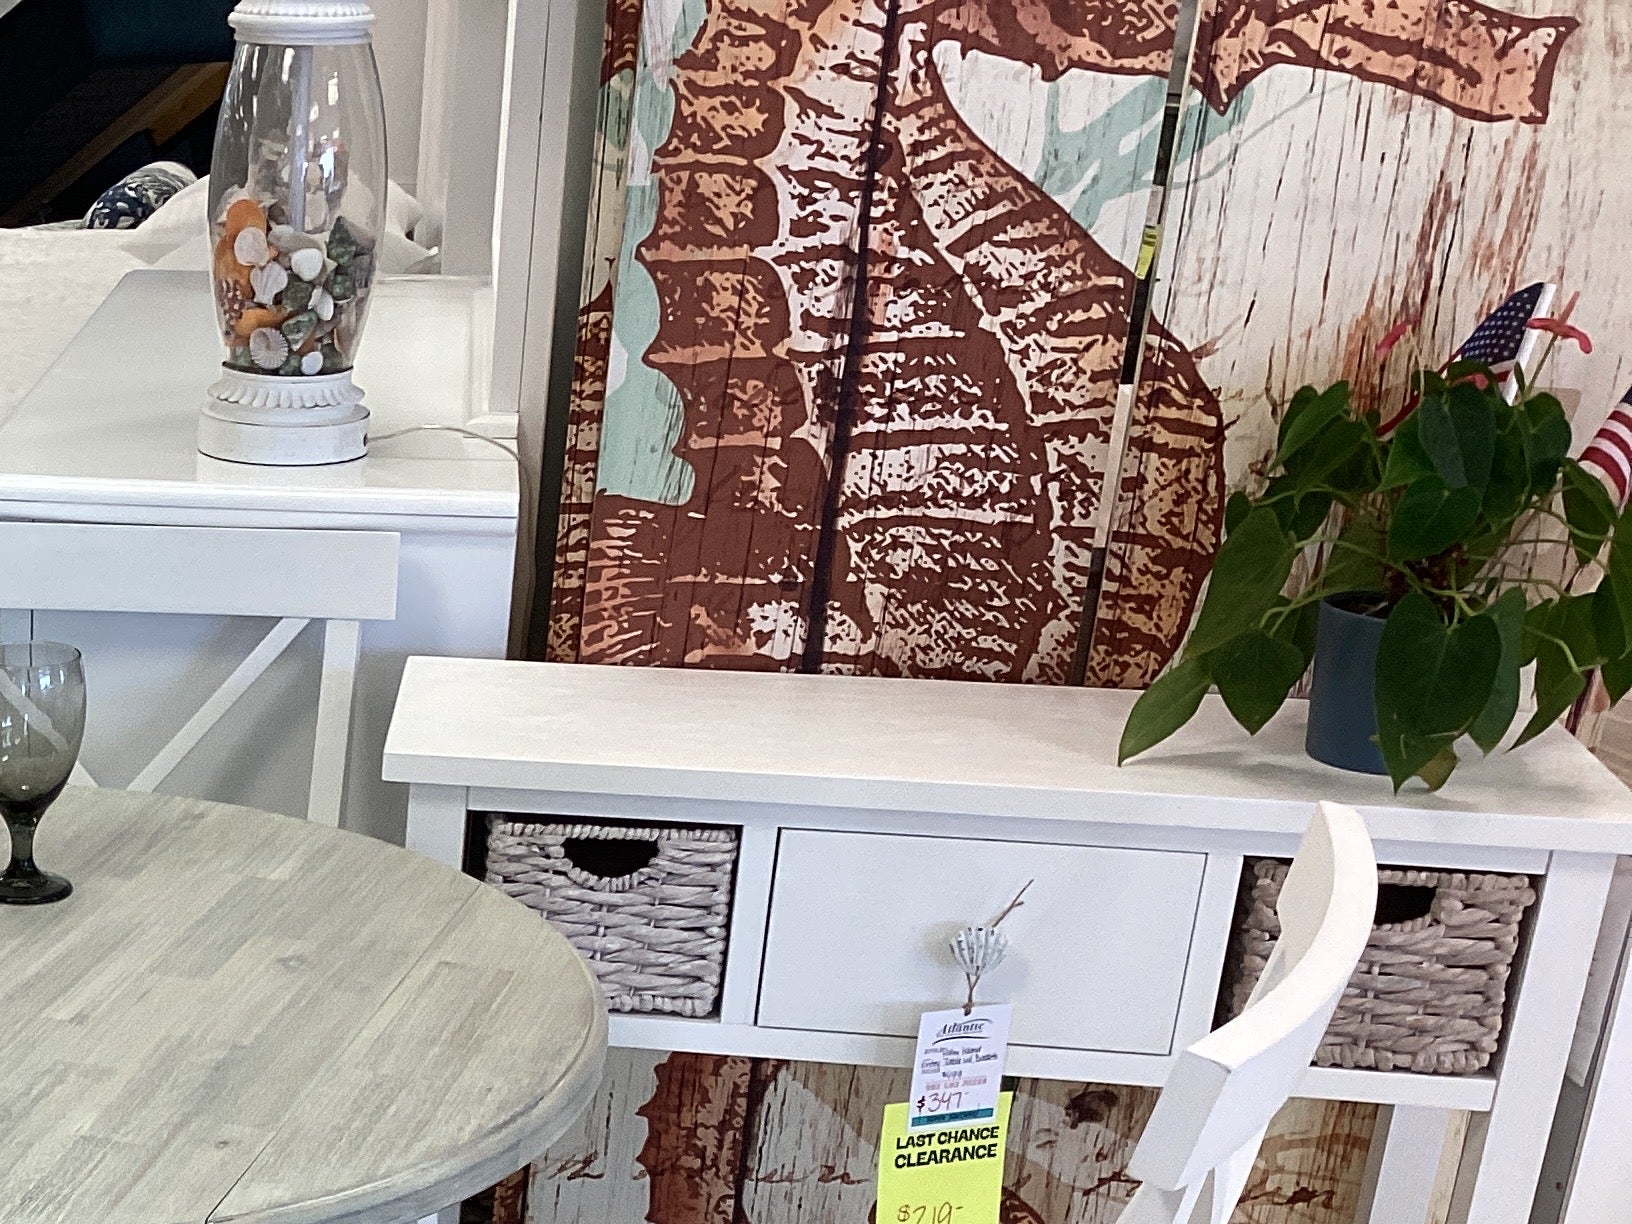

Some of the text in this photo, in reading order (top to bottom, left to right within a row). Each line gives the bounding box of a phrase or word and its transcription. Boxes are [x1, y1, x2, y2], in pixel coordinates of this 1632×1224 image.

[936, 1021, 985, 1037] Atlantic
[896, 1126, 1000, 1150] LAST CHANCE
[894, 1143, 998, 1169] CLEARANCE
